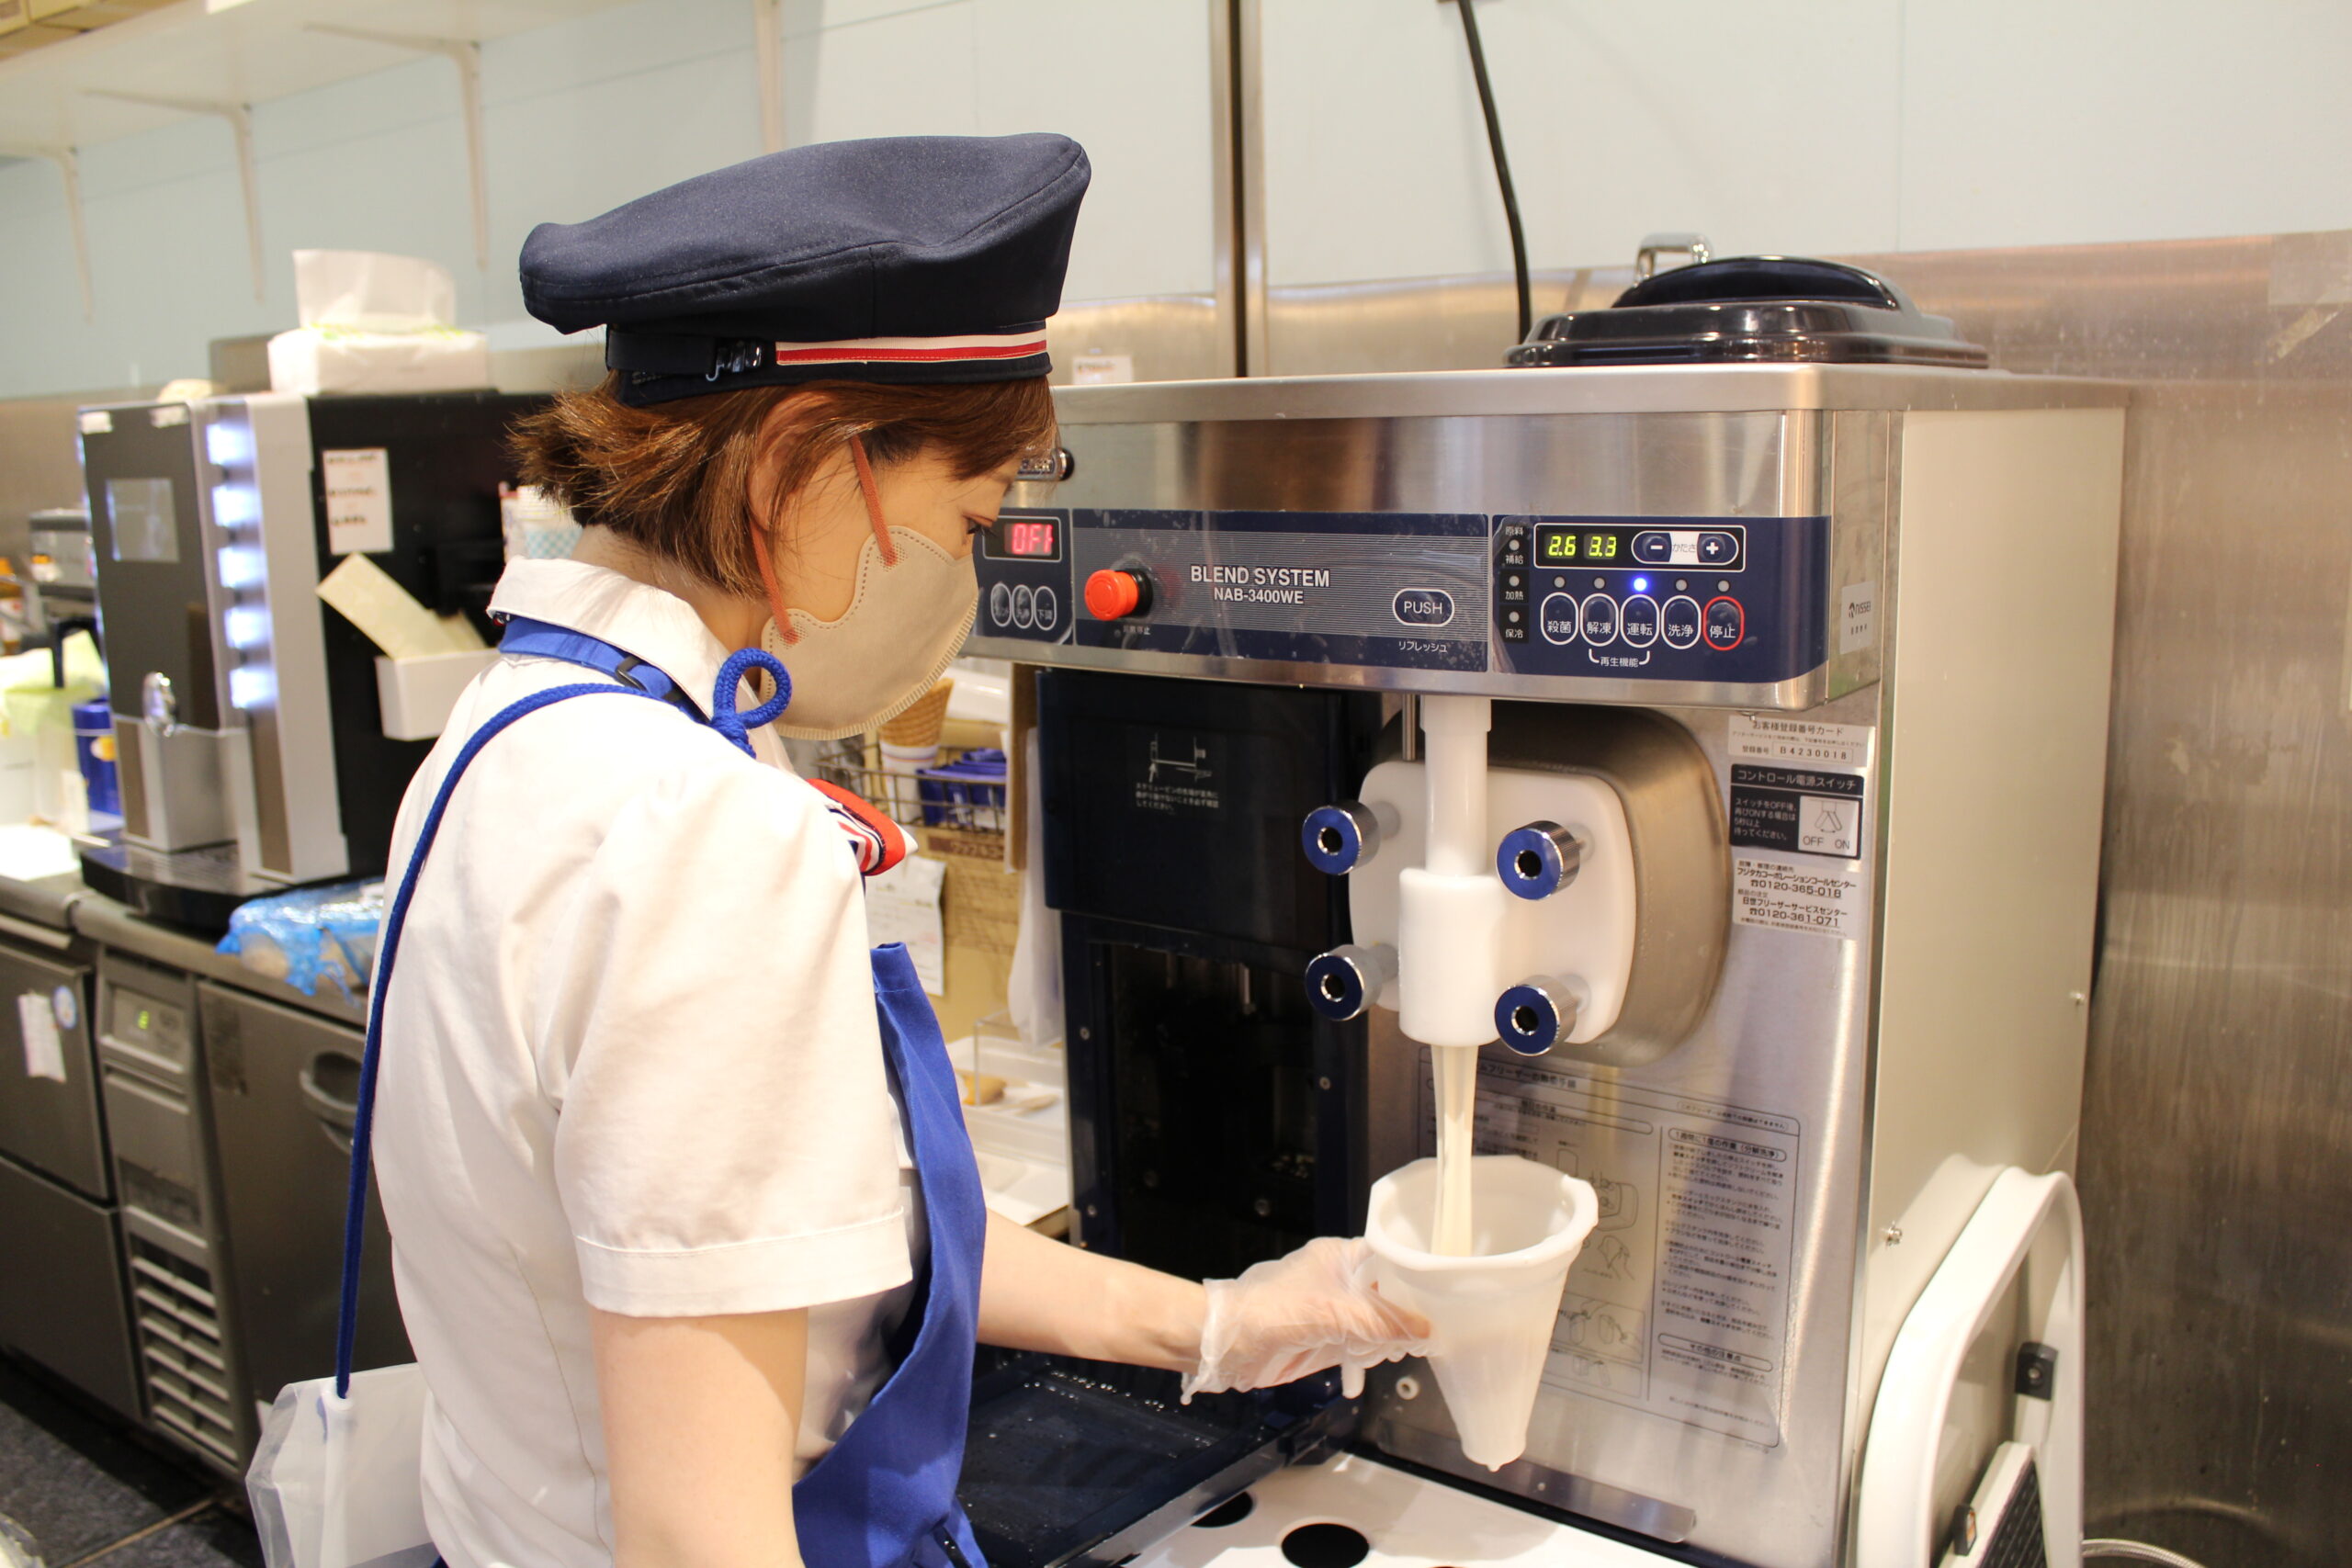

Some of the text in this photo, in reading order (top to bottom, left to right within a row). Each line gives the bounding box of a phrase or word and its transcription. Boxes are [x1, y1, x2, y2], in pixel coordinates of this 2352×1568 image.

[1505, 525, 1524, 536] 原料
[1548, 536, 1617, 558] 2.6 3.3
[1505, 554, 1524, 565] 補給
[1191, 565, 1330, 588] BLEND SYSTEM
[1214, 587, 1304, 605] NAB-3400WE
[1505, 590, 1524, 601] 加熱
[1403, 600, 1443, 615] PUSH
[1505, 628, 1524, 638] 保冷
[1547, 619, 1572, 634] 殺菌
[1587, 621, 1612, 635] 解凍
[1627, 622, 1653, 637] 運転
[1668, 624, 1694, 637] 洗浄
[1709, 625, 1736, 639] 停止
[1398, 640, 1448, 653] リフレッシュ
[1600, 657, 1639, 668] 再生機能
[1737, 770, 1857, 791] コントロール電源スイッチ
[1803, 835, 1850, 850] OFF ON
[1759, 879, 1842, 899] 0120-365-018
[1758, 908, 1839, 927] 0120-361-071
